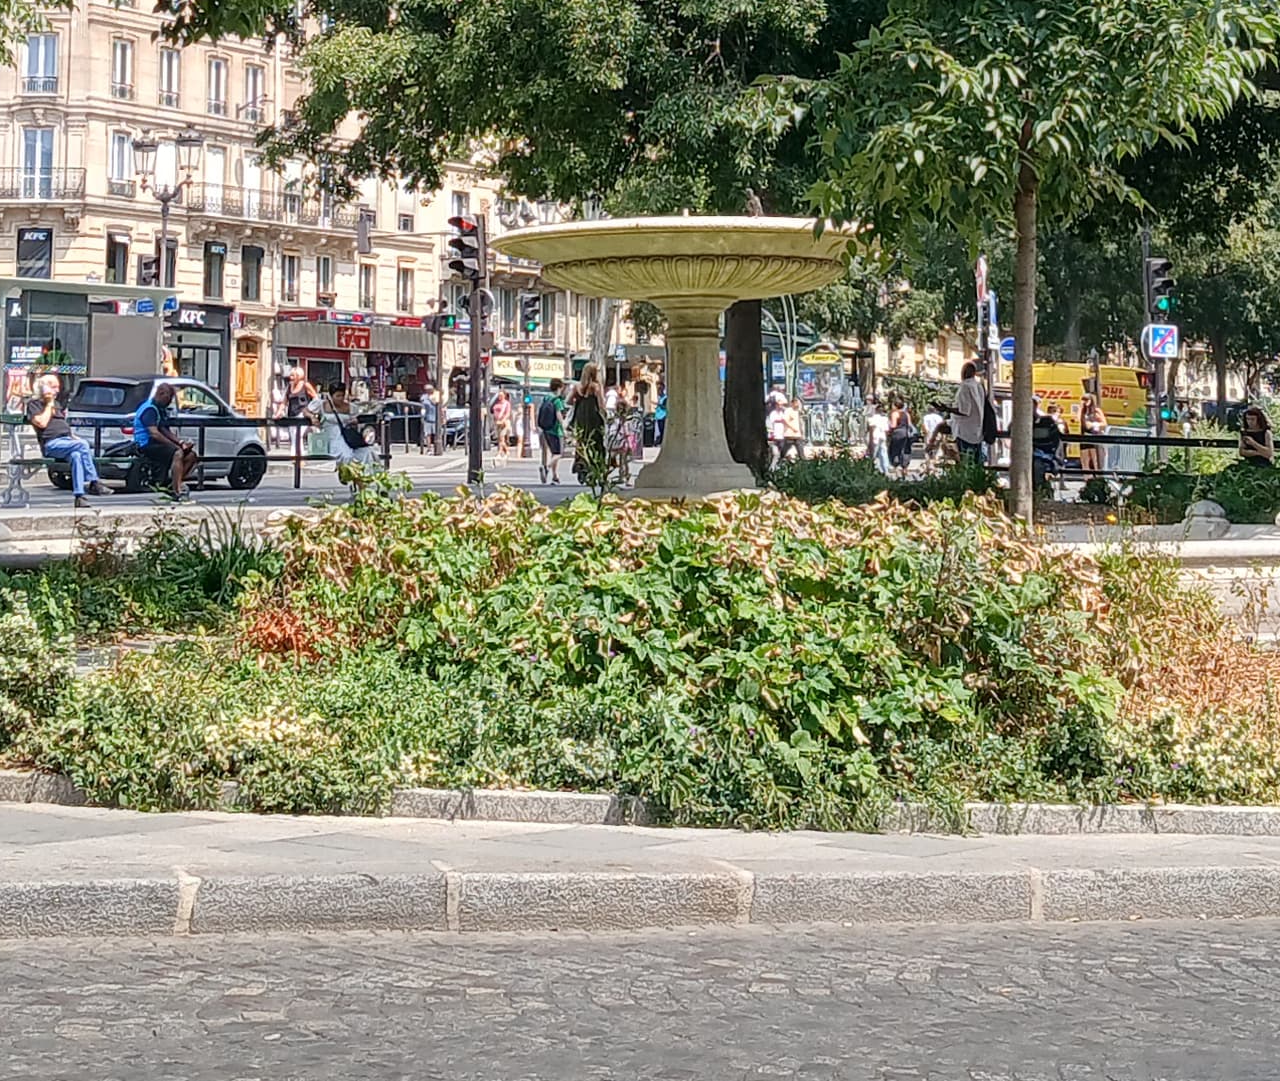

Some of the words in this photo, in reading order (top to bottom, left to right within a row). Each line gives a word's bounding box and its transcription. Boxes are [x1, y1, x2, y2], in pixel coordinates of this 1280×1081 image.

[23, 231, 48, 241] KFC
[179, 309, 207, 325] KFC
[1034, 390, 1072, 399] DHL
[1102, 386, 1128, 399] DHL
